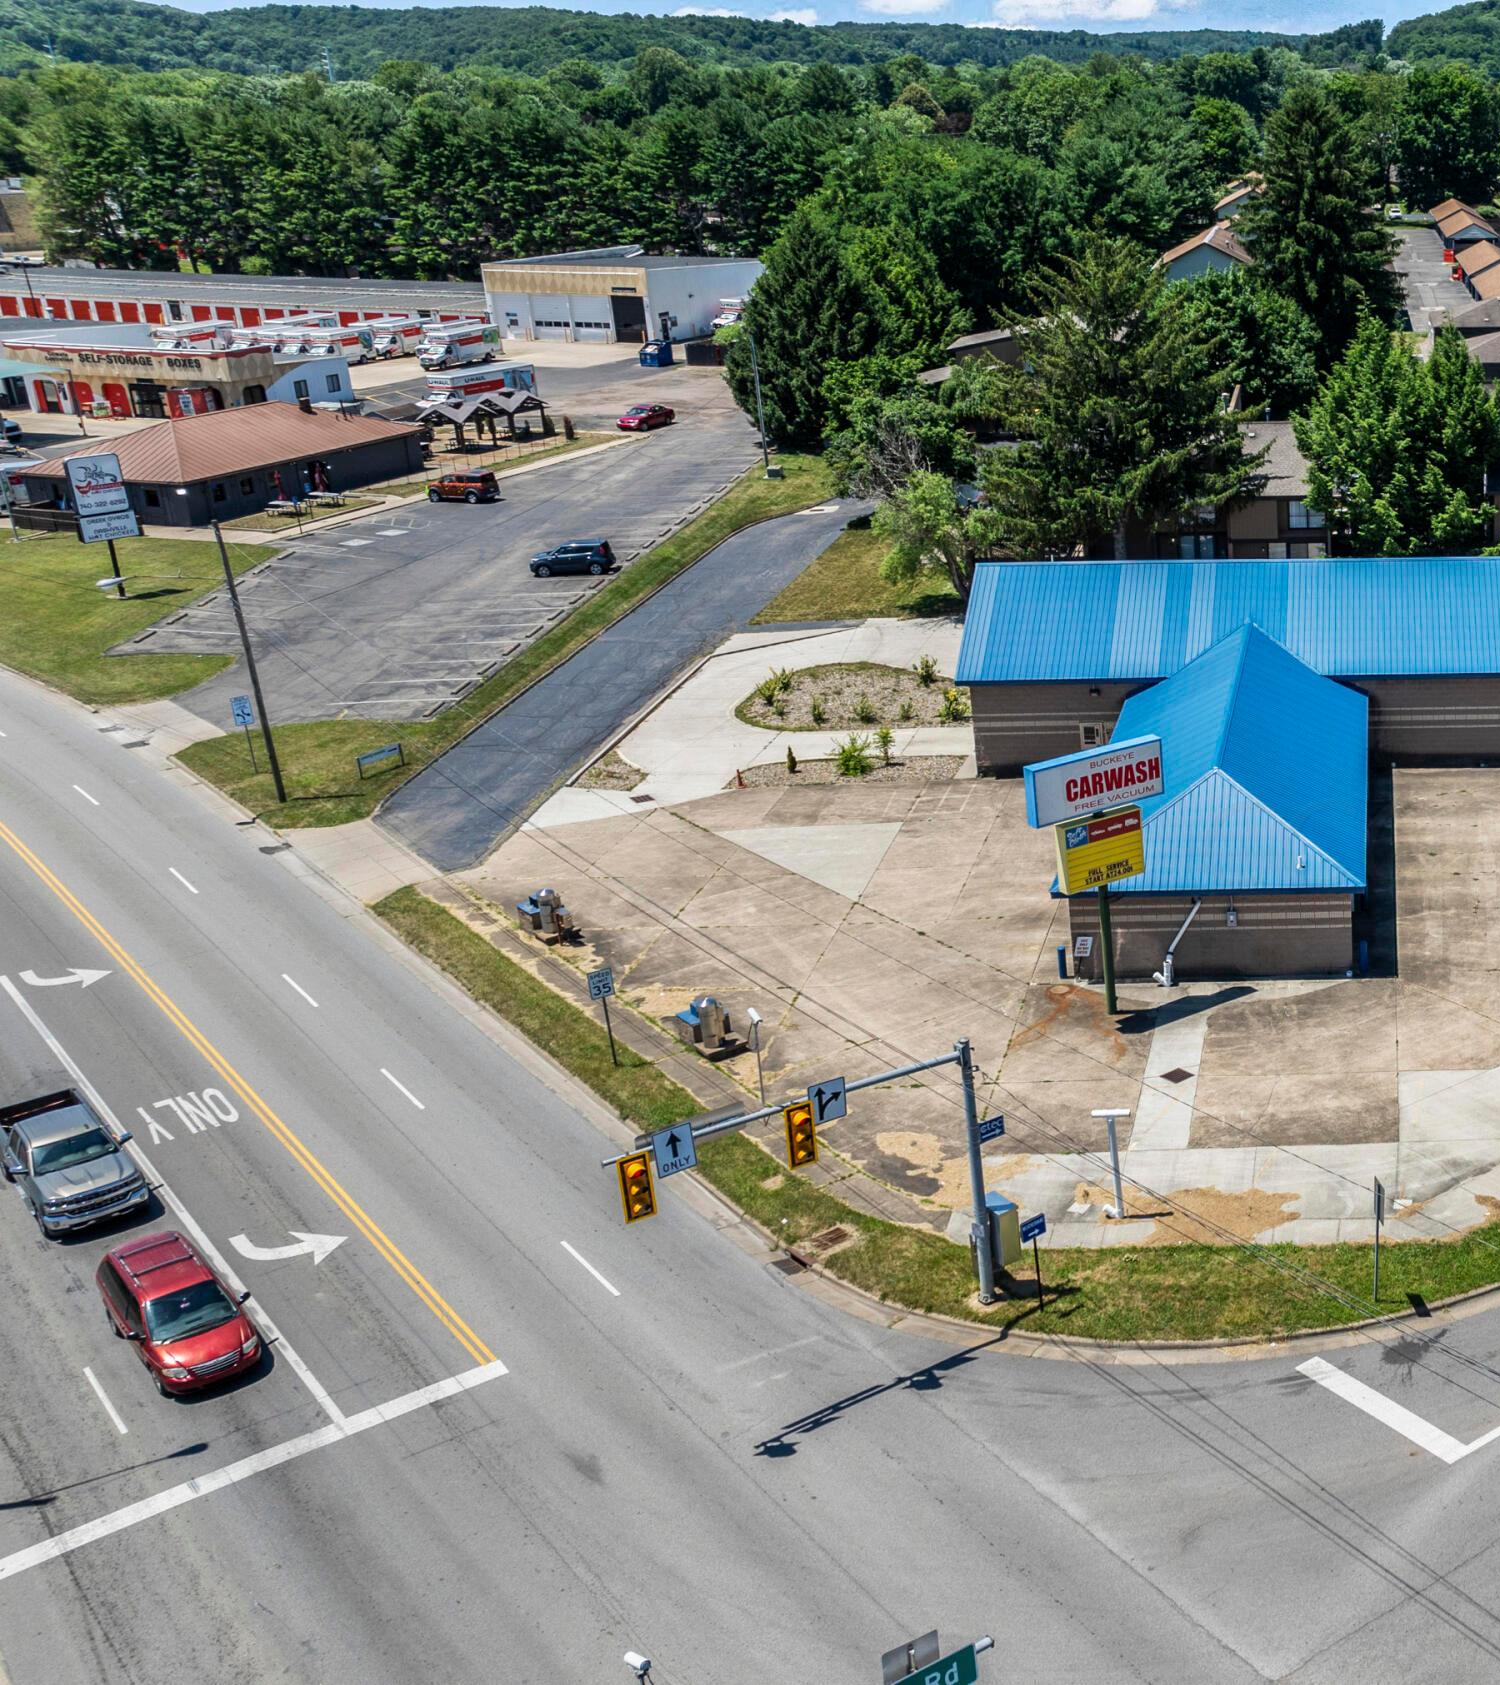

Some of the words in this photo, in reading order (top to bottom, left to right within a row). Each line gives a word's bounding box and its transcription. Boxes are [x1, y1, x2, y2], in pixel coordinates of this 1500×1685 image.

[78, 352, 153, 367] SELF-STORAGE
[167, 357, 202, 370] BOXES
[1089, 751, 1135, 769] BUCKEYE
[1065, 756, 1161, 802] CARWASH
[1074, 798, 1105, 812] FREE
[1107, 784, 1155, 802] VACUUM
[1088, 867, 1103, 877] FULL
[1106, 859, 1129, 871] SERVICE
[589, 971, 610, 980] SPEED
[592, 977, 608, 985] LIMIT
[592, 982, 611, 996] 35
[136, 1088, 239, 1145] ONLY
[662, 1155, 691, 1173] ONLY
